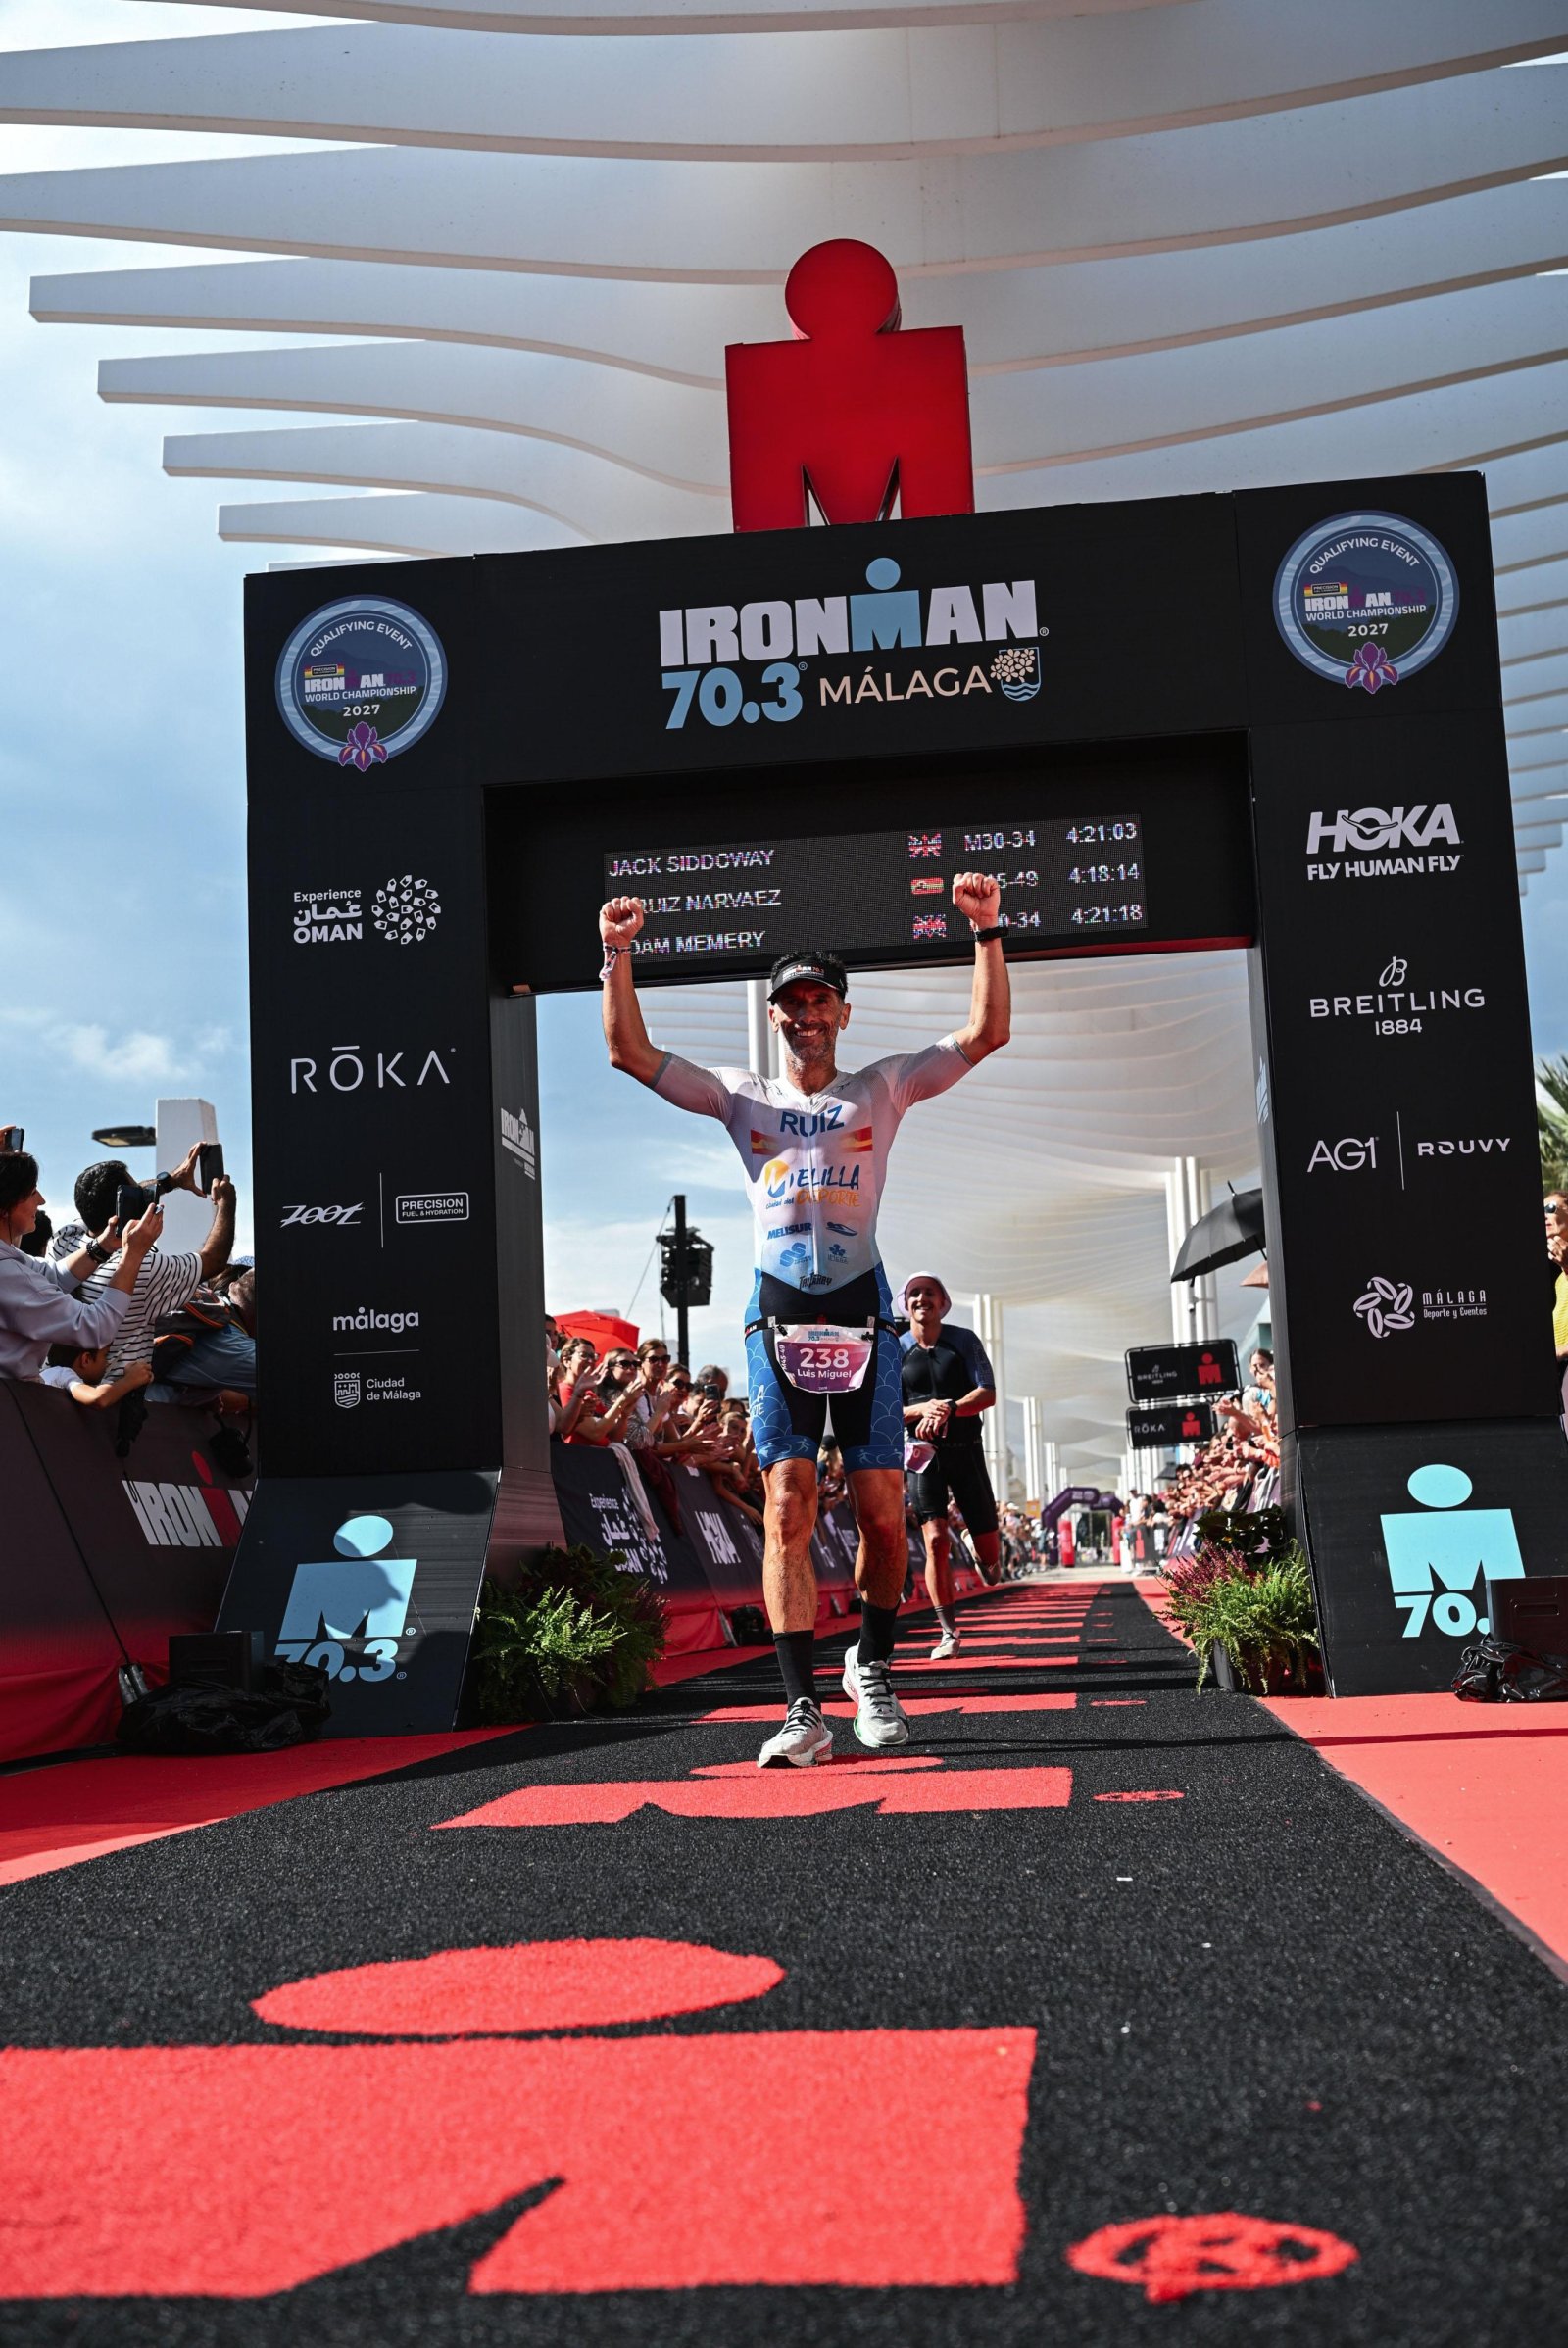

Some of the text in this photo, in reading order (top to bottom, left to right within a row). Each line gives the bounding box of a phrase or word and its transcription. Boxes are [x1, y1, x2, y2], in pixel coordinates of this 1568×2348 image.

[1309, 537, 1420, 574] QUALIFYING EVENT
[659, 558, 1039, 666] IRONMAN
[1306, 604, 1427, 622] WORLD CHAMPIONSHIP
[310, 620, 413, 657] QUALIFYING EVENT
[1348, 623, 1389, 637] 2027
[305, 686, 416, 703] WORLD CHAMPIONSHIP
[661, 662, 993, 730] 70.3 MÁLAGA
[343, 704, 381, 717] 2027
[1066, 822, 1138, 844] 4:21:03
[1306, 803, 1461, 854] HOKA
[964, 830, 1036, 851] M30-34
[609, 857, 662, 877] JACK
[1068, 863, 1139, 884] 4:18:14
[1307, 855, 1461, 881] FLY HUMAN FLY
[294, 889, 362, 904] Experience
[1070, 904, 1144, 924] 4:21:18
[294, 923, 363, 944] OMAN
[630, 931, 766, 956] DAM MEMERY
[1309, 988, 1486, 1018] BREITLING
[1375, 1018, 1423, 1036] 1884
[779, 1104, 845, 1138] RUIZ
[1306, 1137, 1377, 1173] AG1
[1417, 1138, 1511, 1156] ROUVY
[401, 1198, 464, 1210] PRECISION
[1422, 1289, 1487, 1305] MÁLAGA
[1423, 1305, 1488, 1320] Deporte y Eventos
[799, 1347, 850, 1369] 238
[366, 1377, 405, 1388] Ciudad
[797, 1369, 852, 1380] Luis Miguel
[367, 1390, 421, 1400] de Málaga
